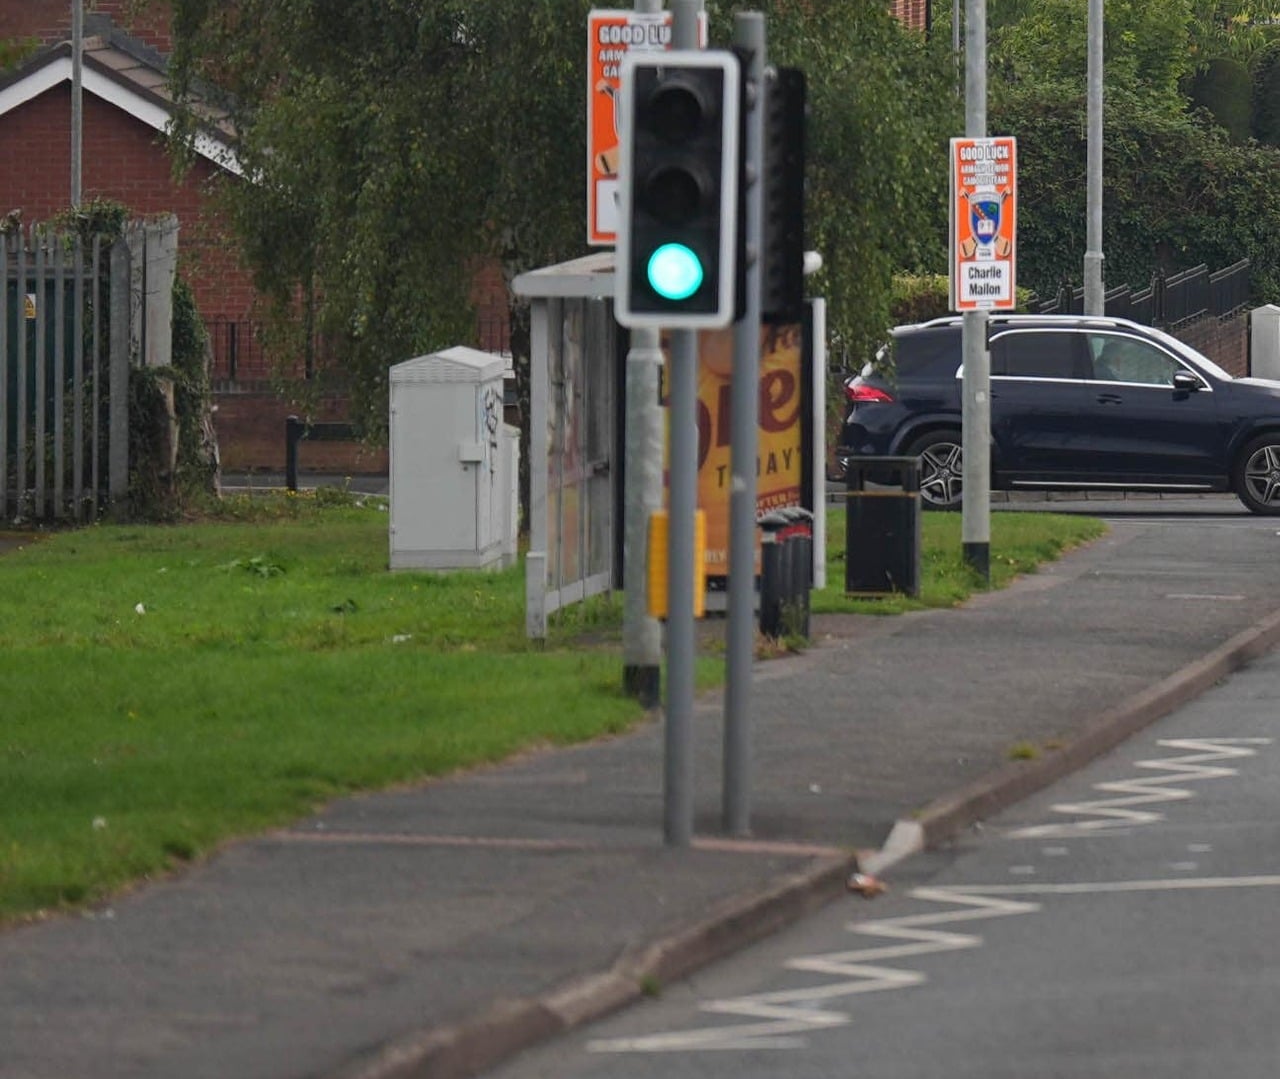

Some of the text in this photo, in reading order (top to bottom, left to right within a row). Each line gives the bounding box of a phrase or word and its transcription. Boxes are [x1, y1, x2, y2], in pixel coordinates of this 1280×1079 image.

[599, 24, 645, 45] GOOD
[960, 145, 1009, 160] GOOD LUCK
[968, 266, 1002, 280] Charlie
[969, 283, 1001, 296] Mallon
